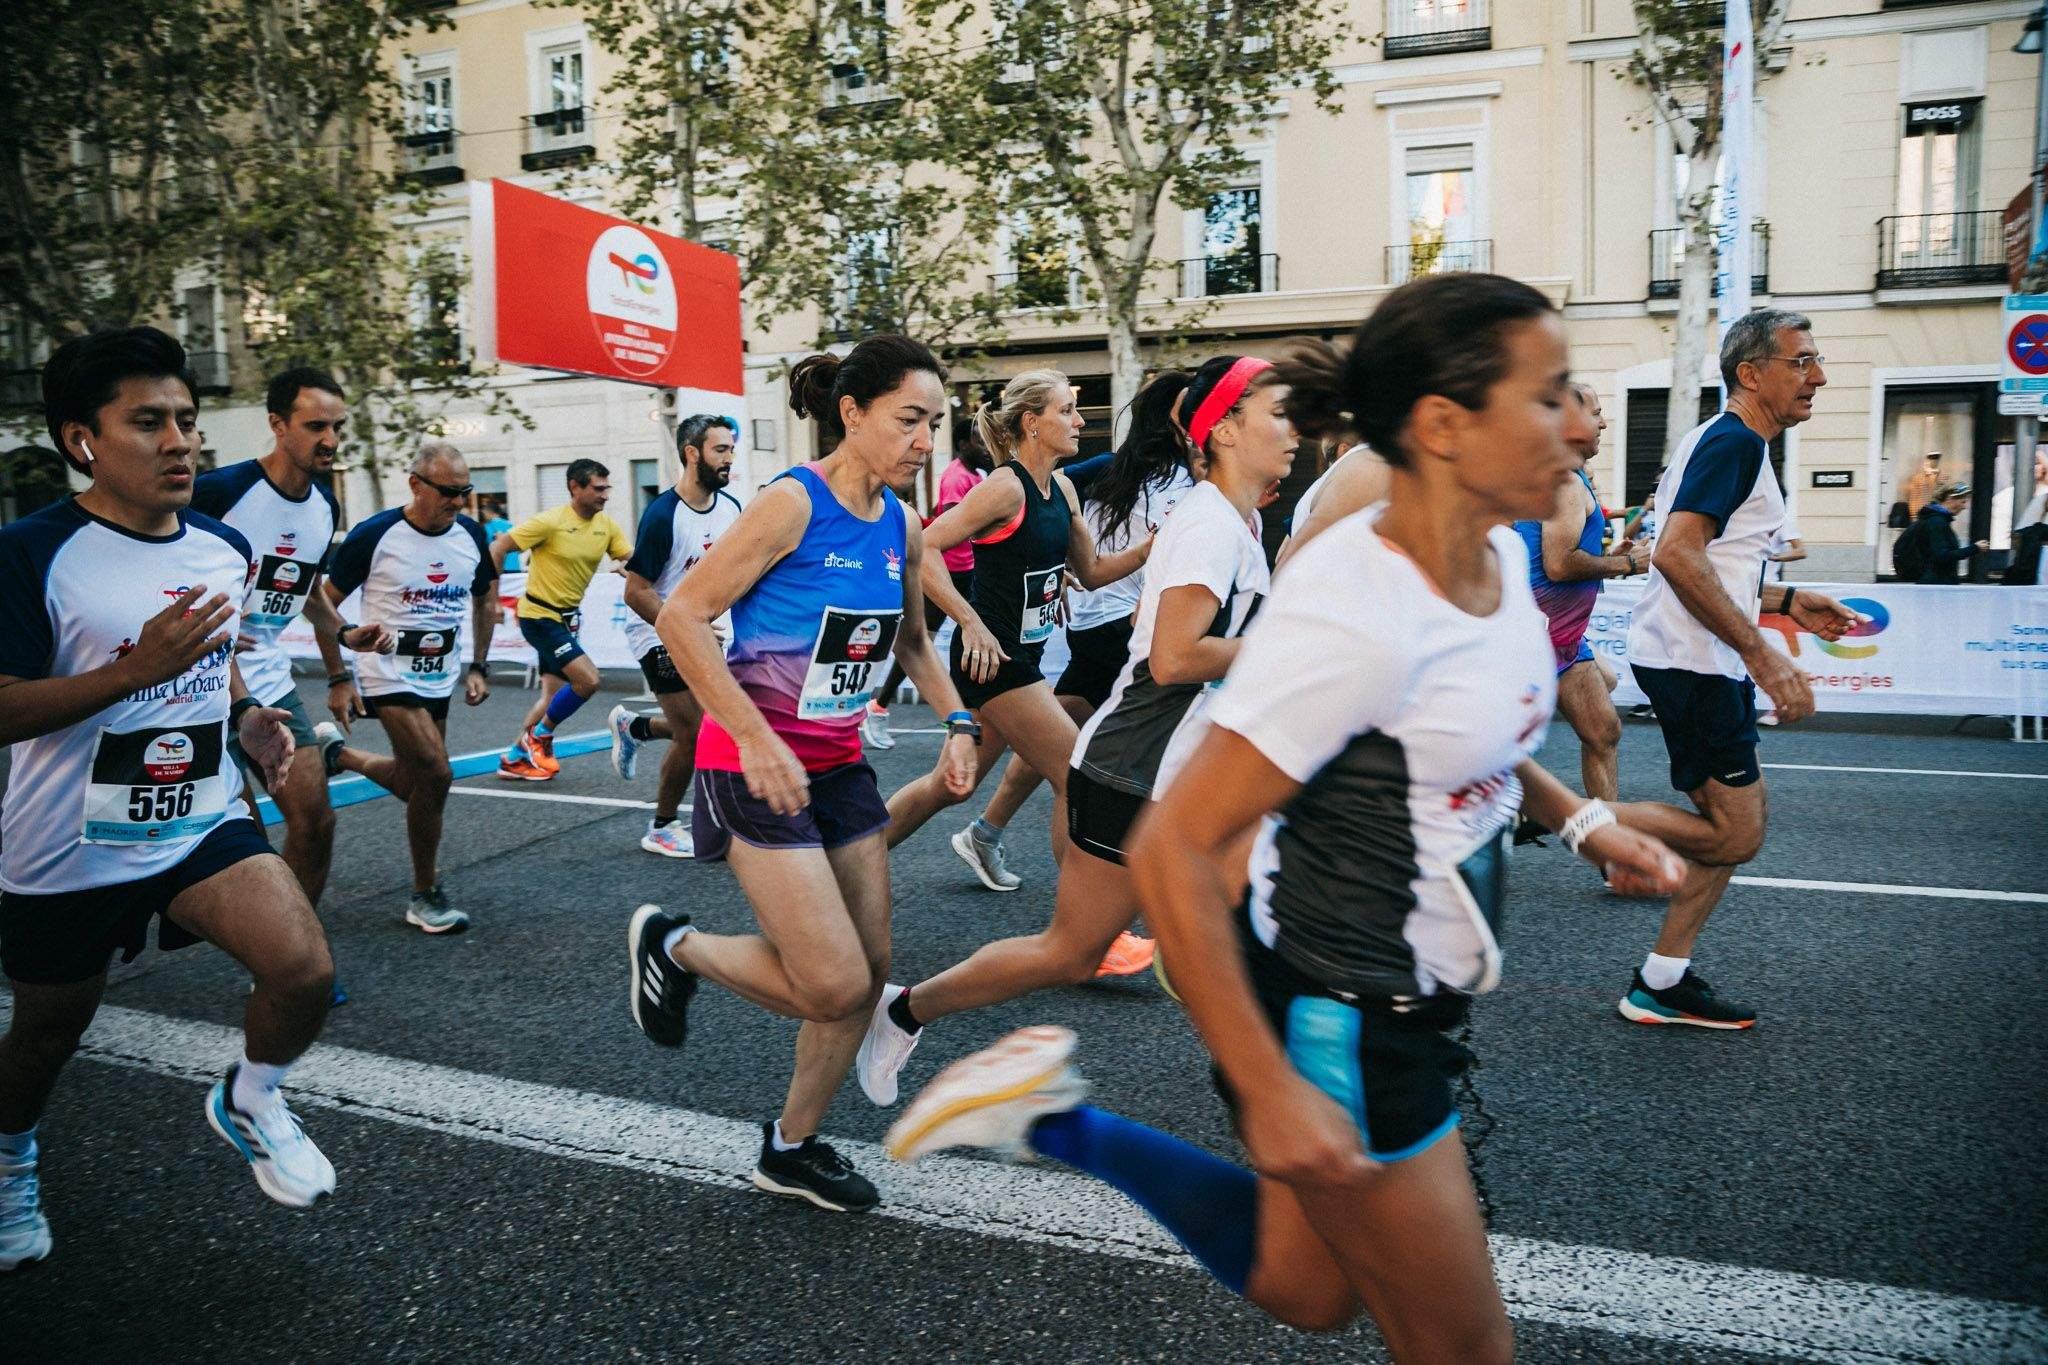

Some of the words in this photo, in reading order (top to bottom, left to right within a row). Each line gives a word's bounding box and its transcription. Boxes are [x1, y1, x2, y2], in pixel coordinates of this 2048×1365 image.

[1911, 105, 1962, 121] BOSS
[261, 592, 294, 616] 566
[411, 656, 444, 673] 554
[165, 694, 193, 706] Madrid
[128, 782, 196, 823] 556
